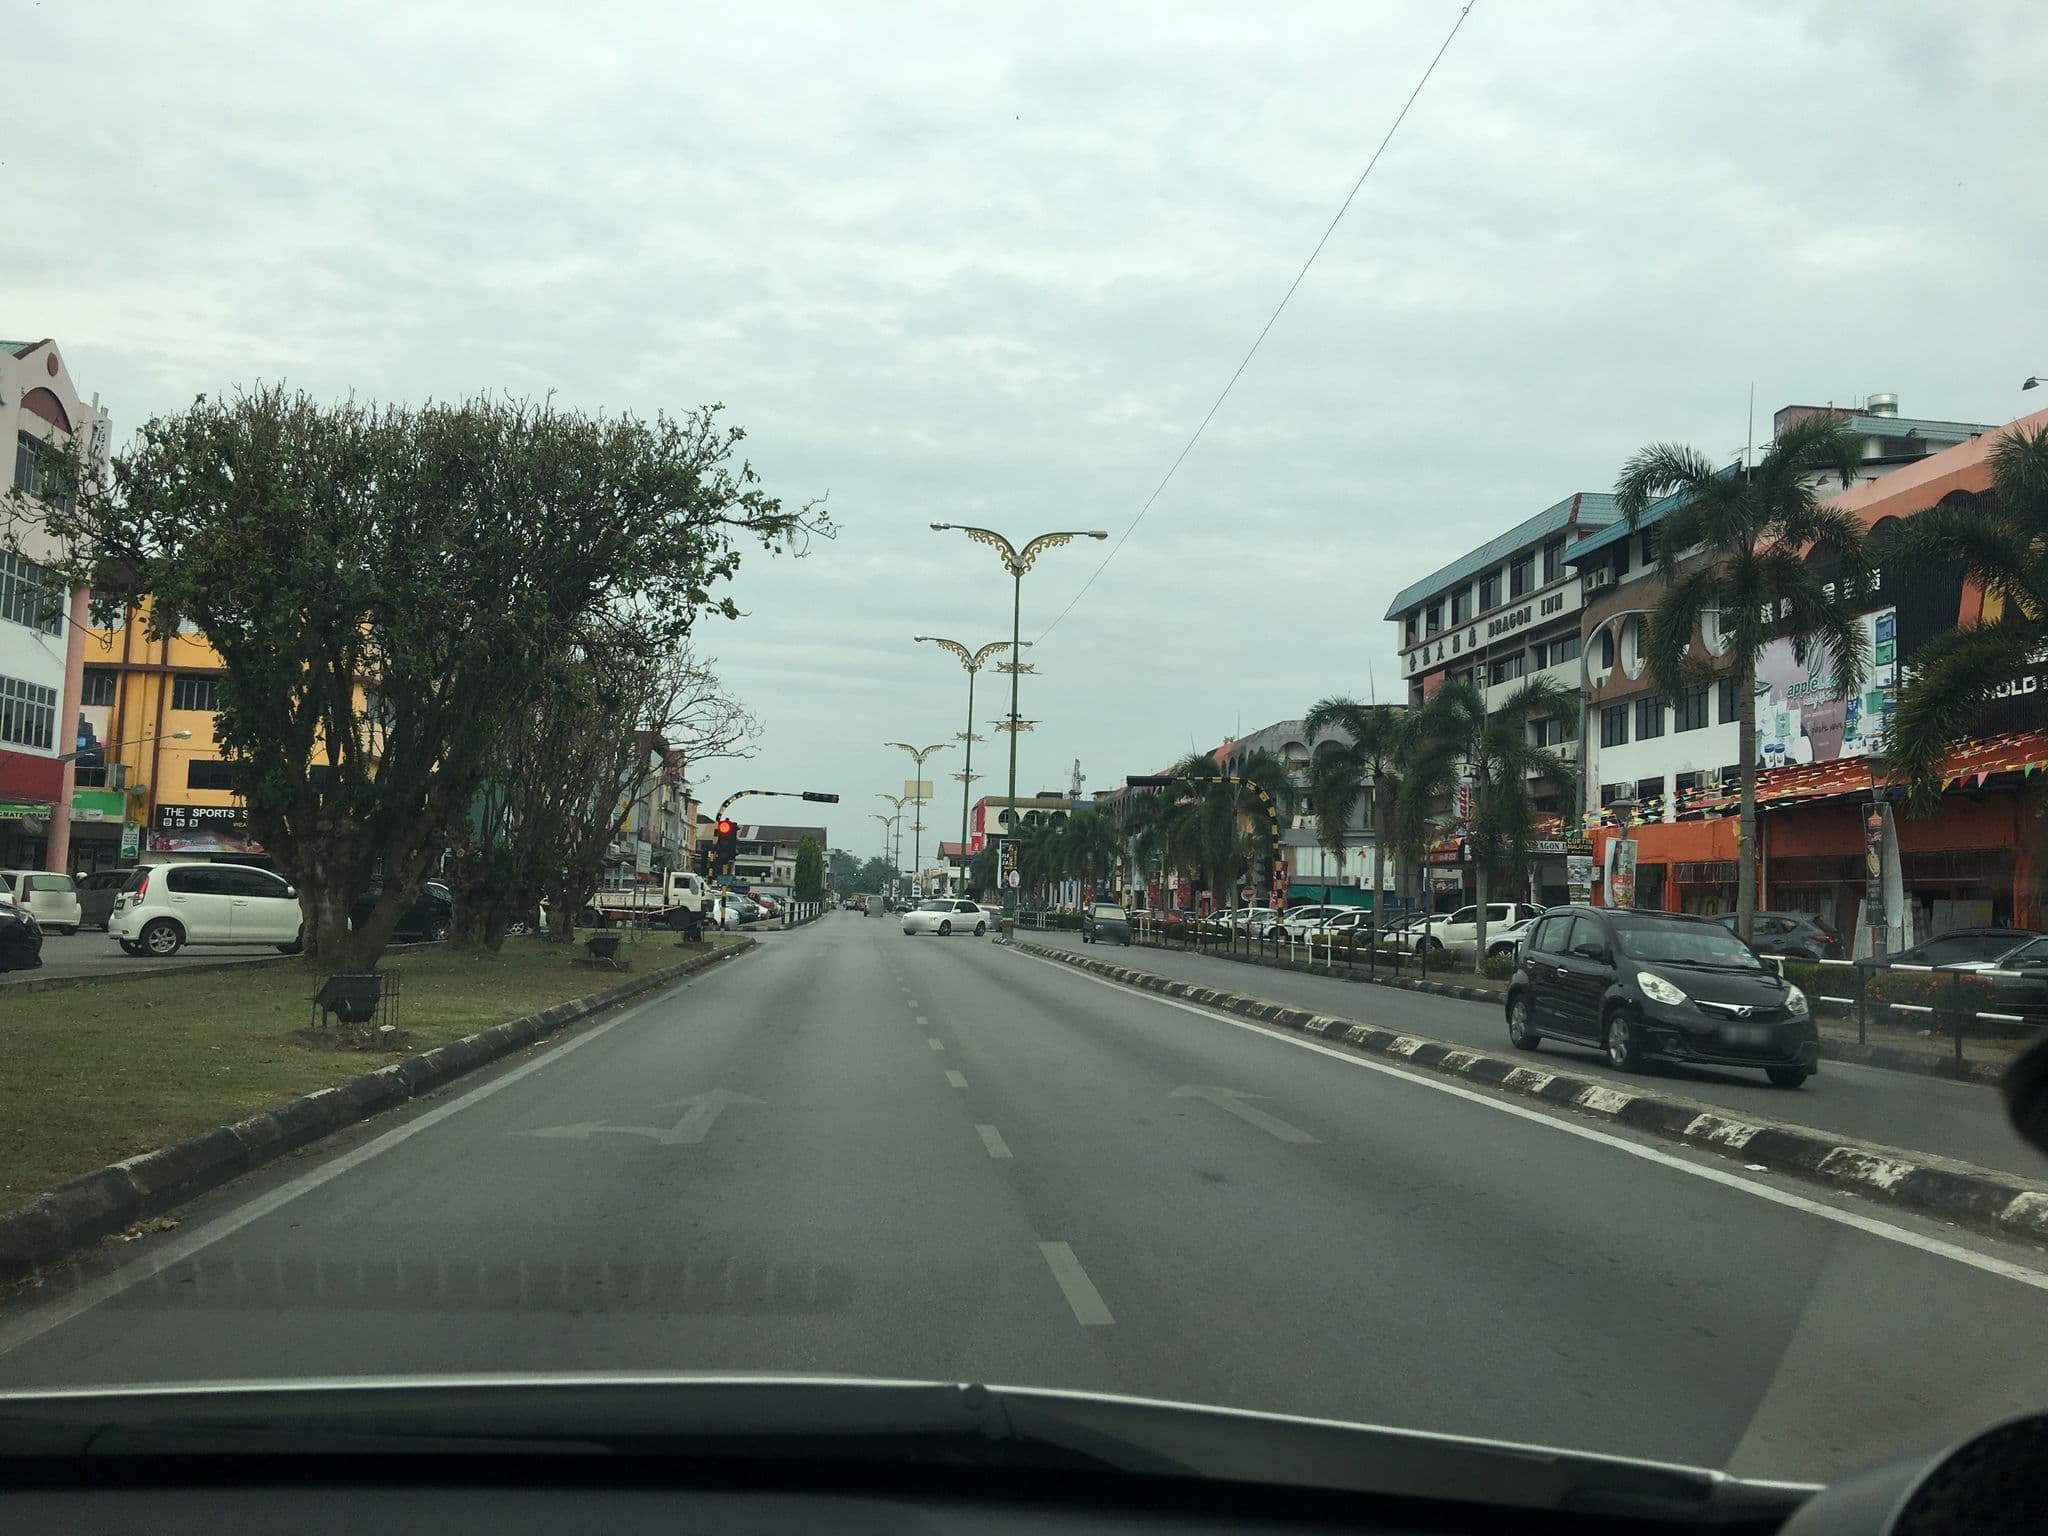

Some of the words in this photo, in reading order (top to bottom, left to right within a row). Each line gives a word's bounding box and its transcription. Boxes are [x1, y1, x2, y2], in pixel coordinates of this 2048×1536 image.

[1487, 605, 1532, 638] DRAGON
[1540, 591, 1563, 617] INN
[164, 807, 185, 818] THE
[192, 808, 236, 819] SPORTS
